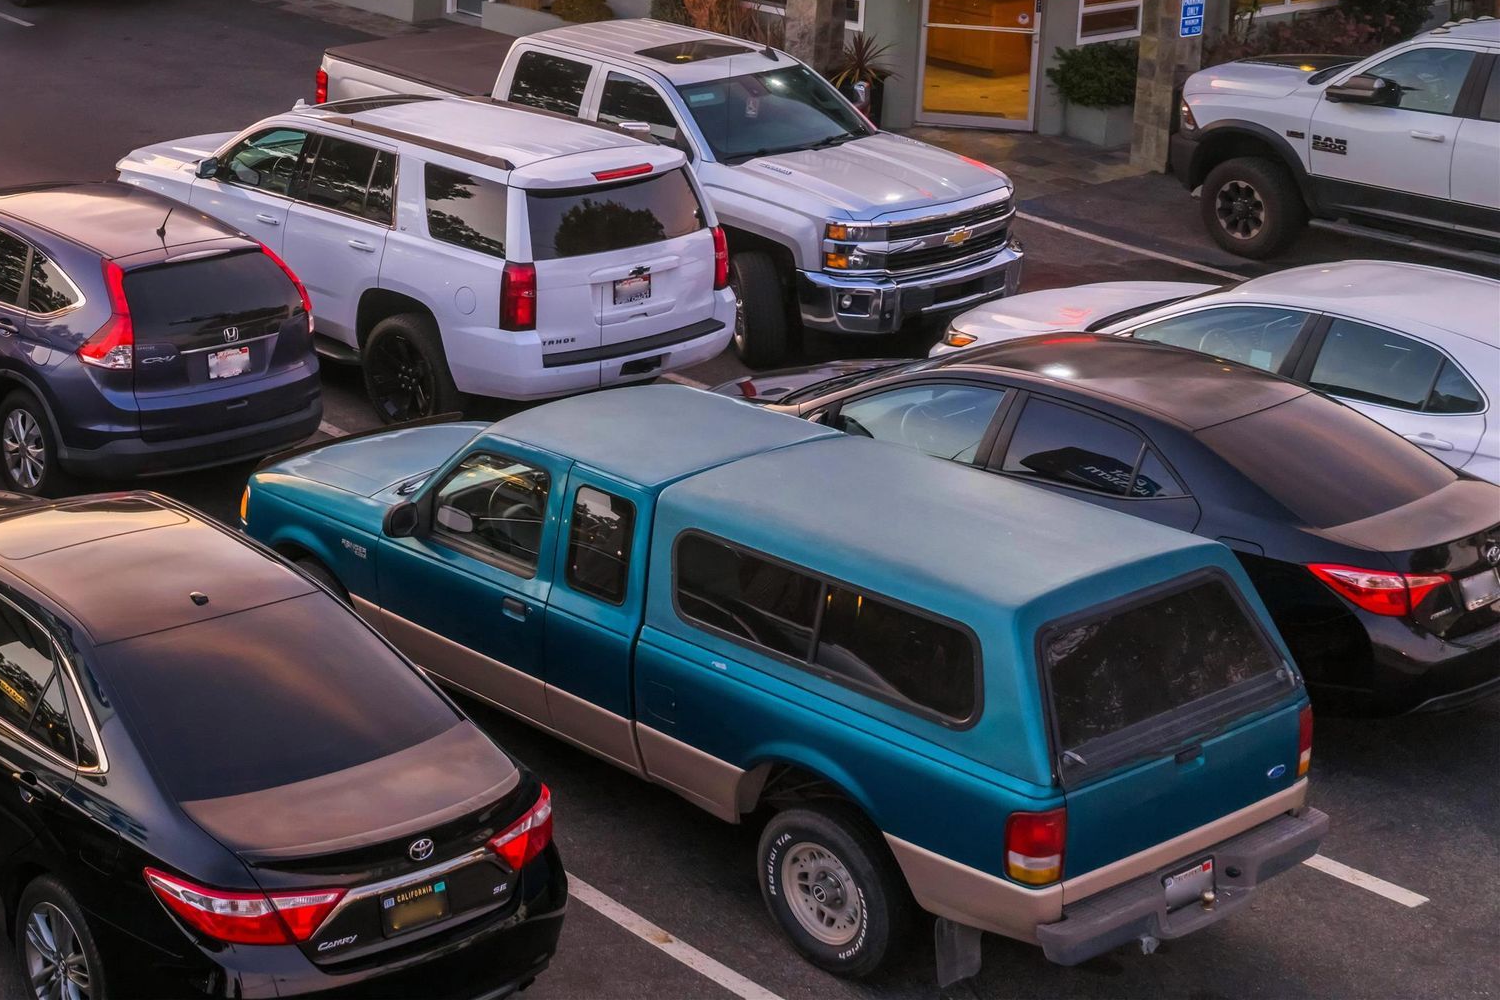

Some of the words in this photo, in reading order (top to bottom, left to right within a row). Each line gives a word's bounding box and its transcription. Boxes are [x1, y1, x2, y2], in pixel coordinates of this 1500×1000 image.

[1312, 134, 1347, 145] RAM
[1312, 141, 1347, 151] 2500
[542, 337, 576, 346] TAHOE
[776, 833, 792, 846] T/A
[766, 850, 778, 896] Radial
[396, 885, 433, 903] CALIFORNIA
[492, 882, 508, 895] SE
